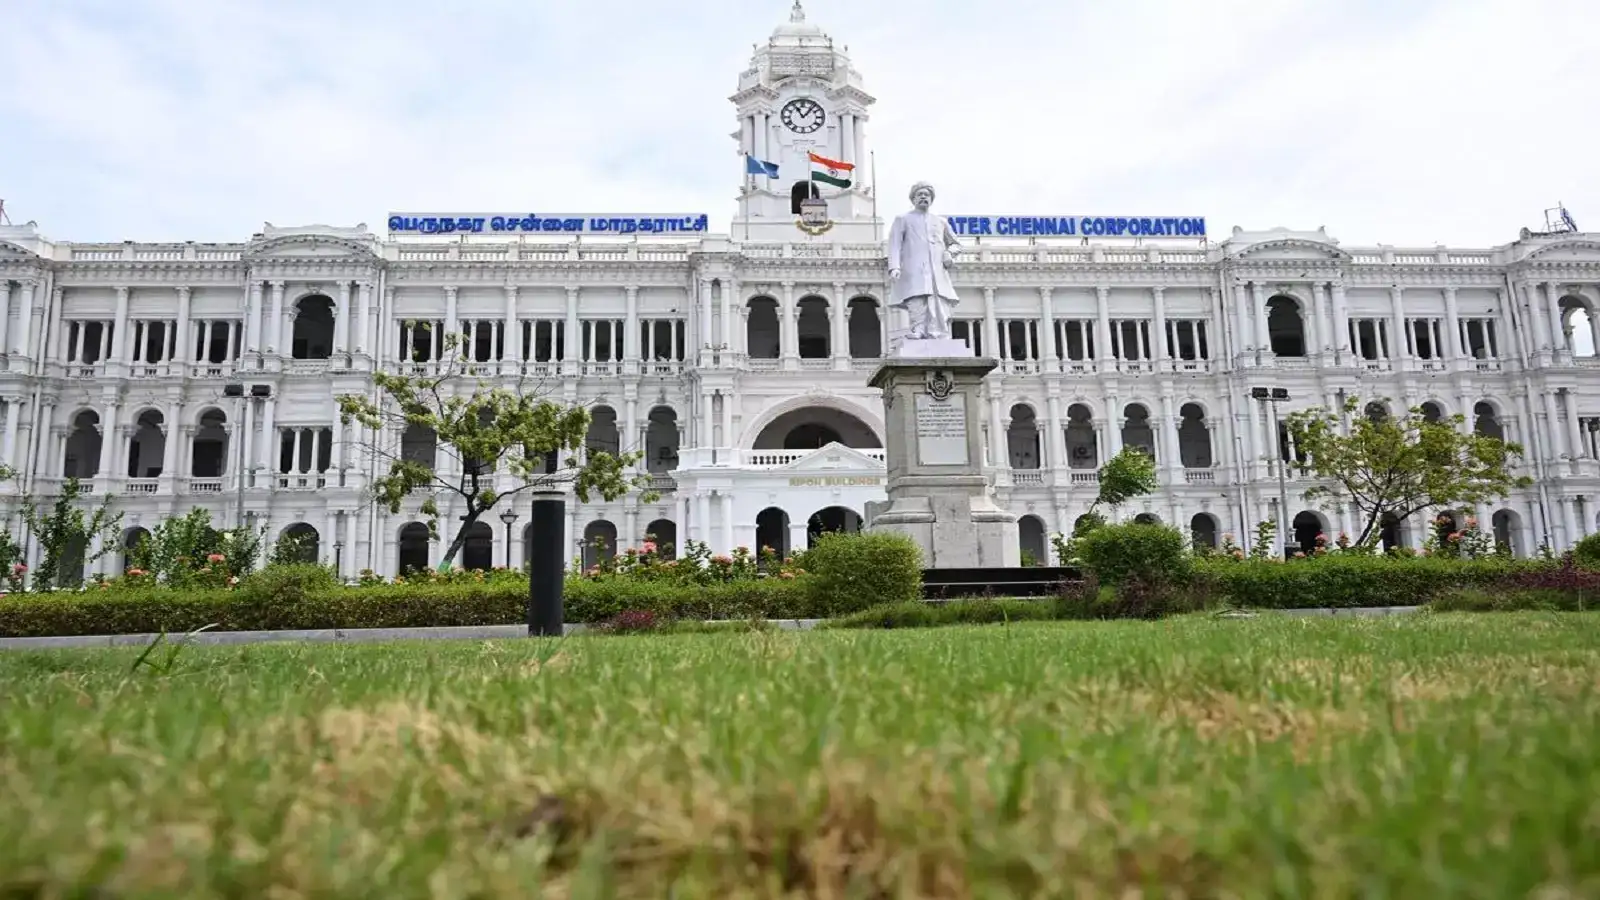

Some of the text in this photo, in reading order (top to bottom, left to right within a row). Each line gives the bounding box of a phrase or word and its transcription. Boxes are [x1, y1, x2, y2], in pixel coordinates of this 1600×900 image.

[388, 216, 484, 233] பெருநகர
[590, 214, 708, 233] மாநகராட்சி
[996, 217, 1075, 235] CHENNAI
[1080, 217, 1205, 235] CORPORATION
